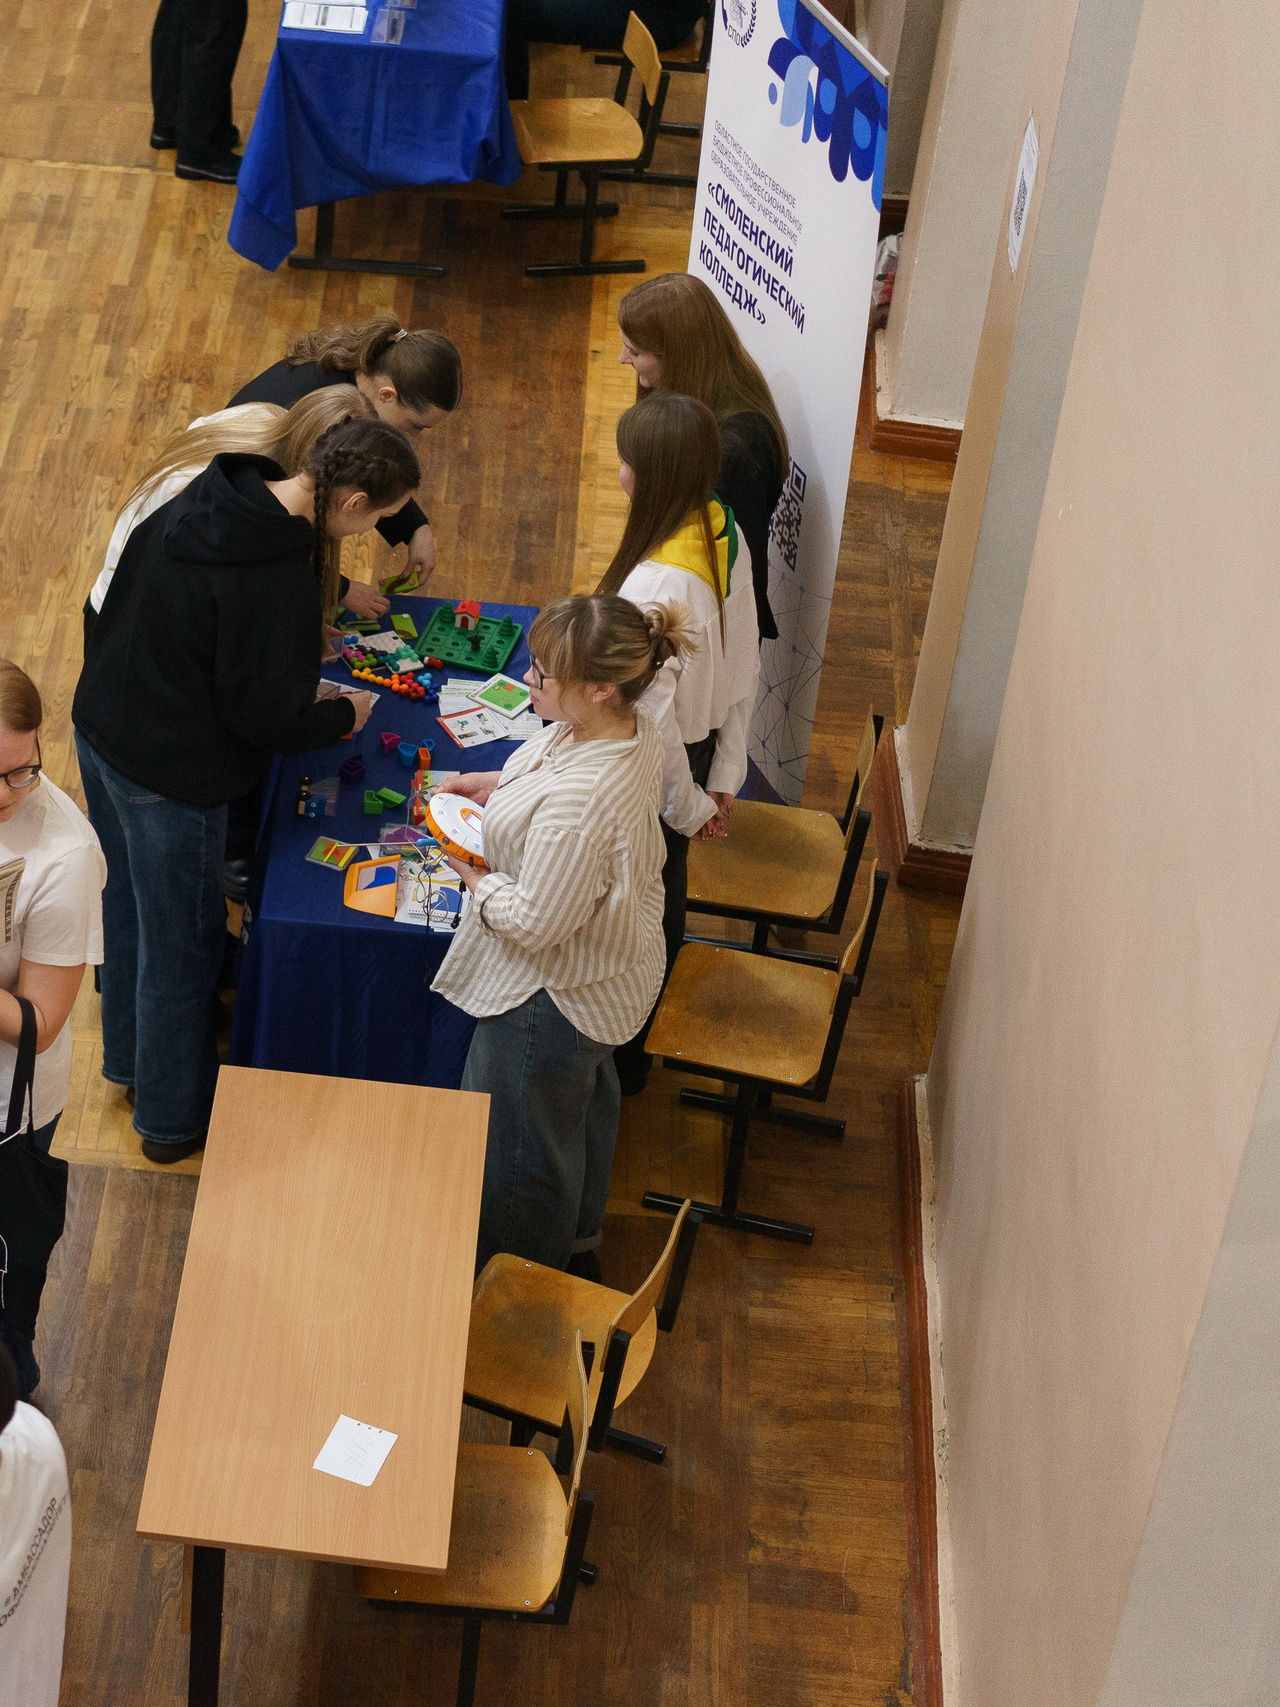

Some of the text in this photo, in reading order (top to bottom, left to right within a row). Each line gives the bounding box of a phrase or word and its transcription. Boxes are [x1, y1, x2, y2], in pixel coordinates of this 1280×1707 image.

[711, 150, 798, 246] ОБРАЗОВАТЕЛЬНОЕ УЧРЕЖДЕНИЕ
[713, 135, 803, 235] БЮДЖЕТНОЕ ПРОФЕССИОНАЛЬНОЕ
[714, 120, 797, 209] ОБЛАСТНОЕ ГОСУДАРСТВЕННОЕ
[703, 207, 805, 335] ПЕДАГОГИЧЕСКИЙ
[707, 182, 794, 278] «СМОЛЕНСКИЙ
[699, 240, 766, 325] КОЛЛЕДЖ»
